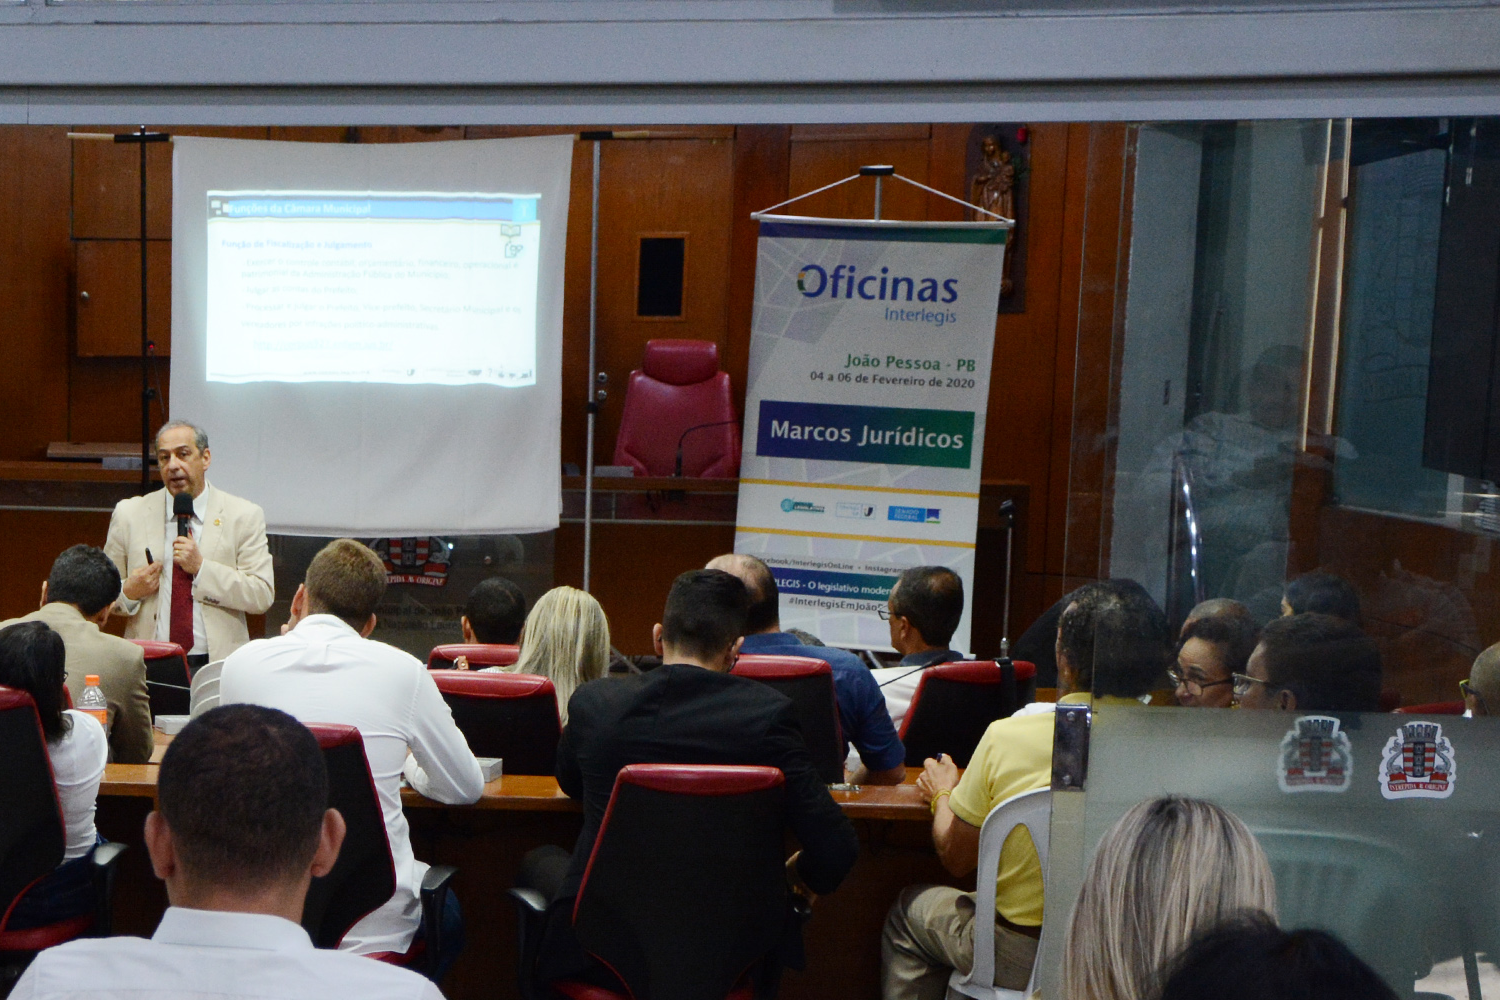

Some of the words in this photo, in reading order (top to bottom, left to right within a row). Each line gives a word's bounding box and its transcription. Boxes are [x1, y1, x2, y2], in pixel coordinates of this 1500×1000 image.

[229, 203, 268, 214] Funções
[270, 204, 282, 213] da
[284, 202, 321, 213] Câmara
[323, 204, 371, 214] Municipal
[222, 239, 251, 249] Função
[254, 239, 264, 248] de
[267, 238, 315, 250] Fiscalização
[324, 240, 372, 250] Julgamento
[798, 264, 958, 303] Oficinas
[885, 307, 957, 327] Interlegis
[845, 353, 880, 368] João
[886, 356, 940, 370] Pessoa
[957, 358, 976, 372] PB
[810, 372, 823, 381] 04
[827, 374, 833, 382] a
[838, 372, 852, 382] 06
[855, 374, 869, 384] de
[872, 374, 925, 386] Fevereiro
[928, 376, 942, 388] de
[946, 378, 976, 388] 2020
[770, 420, 851, 443] Marcos
[856, 425, 964, 449] Jurídicos
[808, 581, 816, 590] O
[818, 582, 860, 594] legislativo
